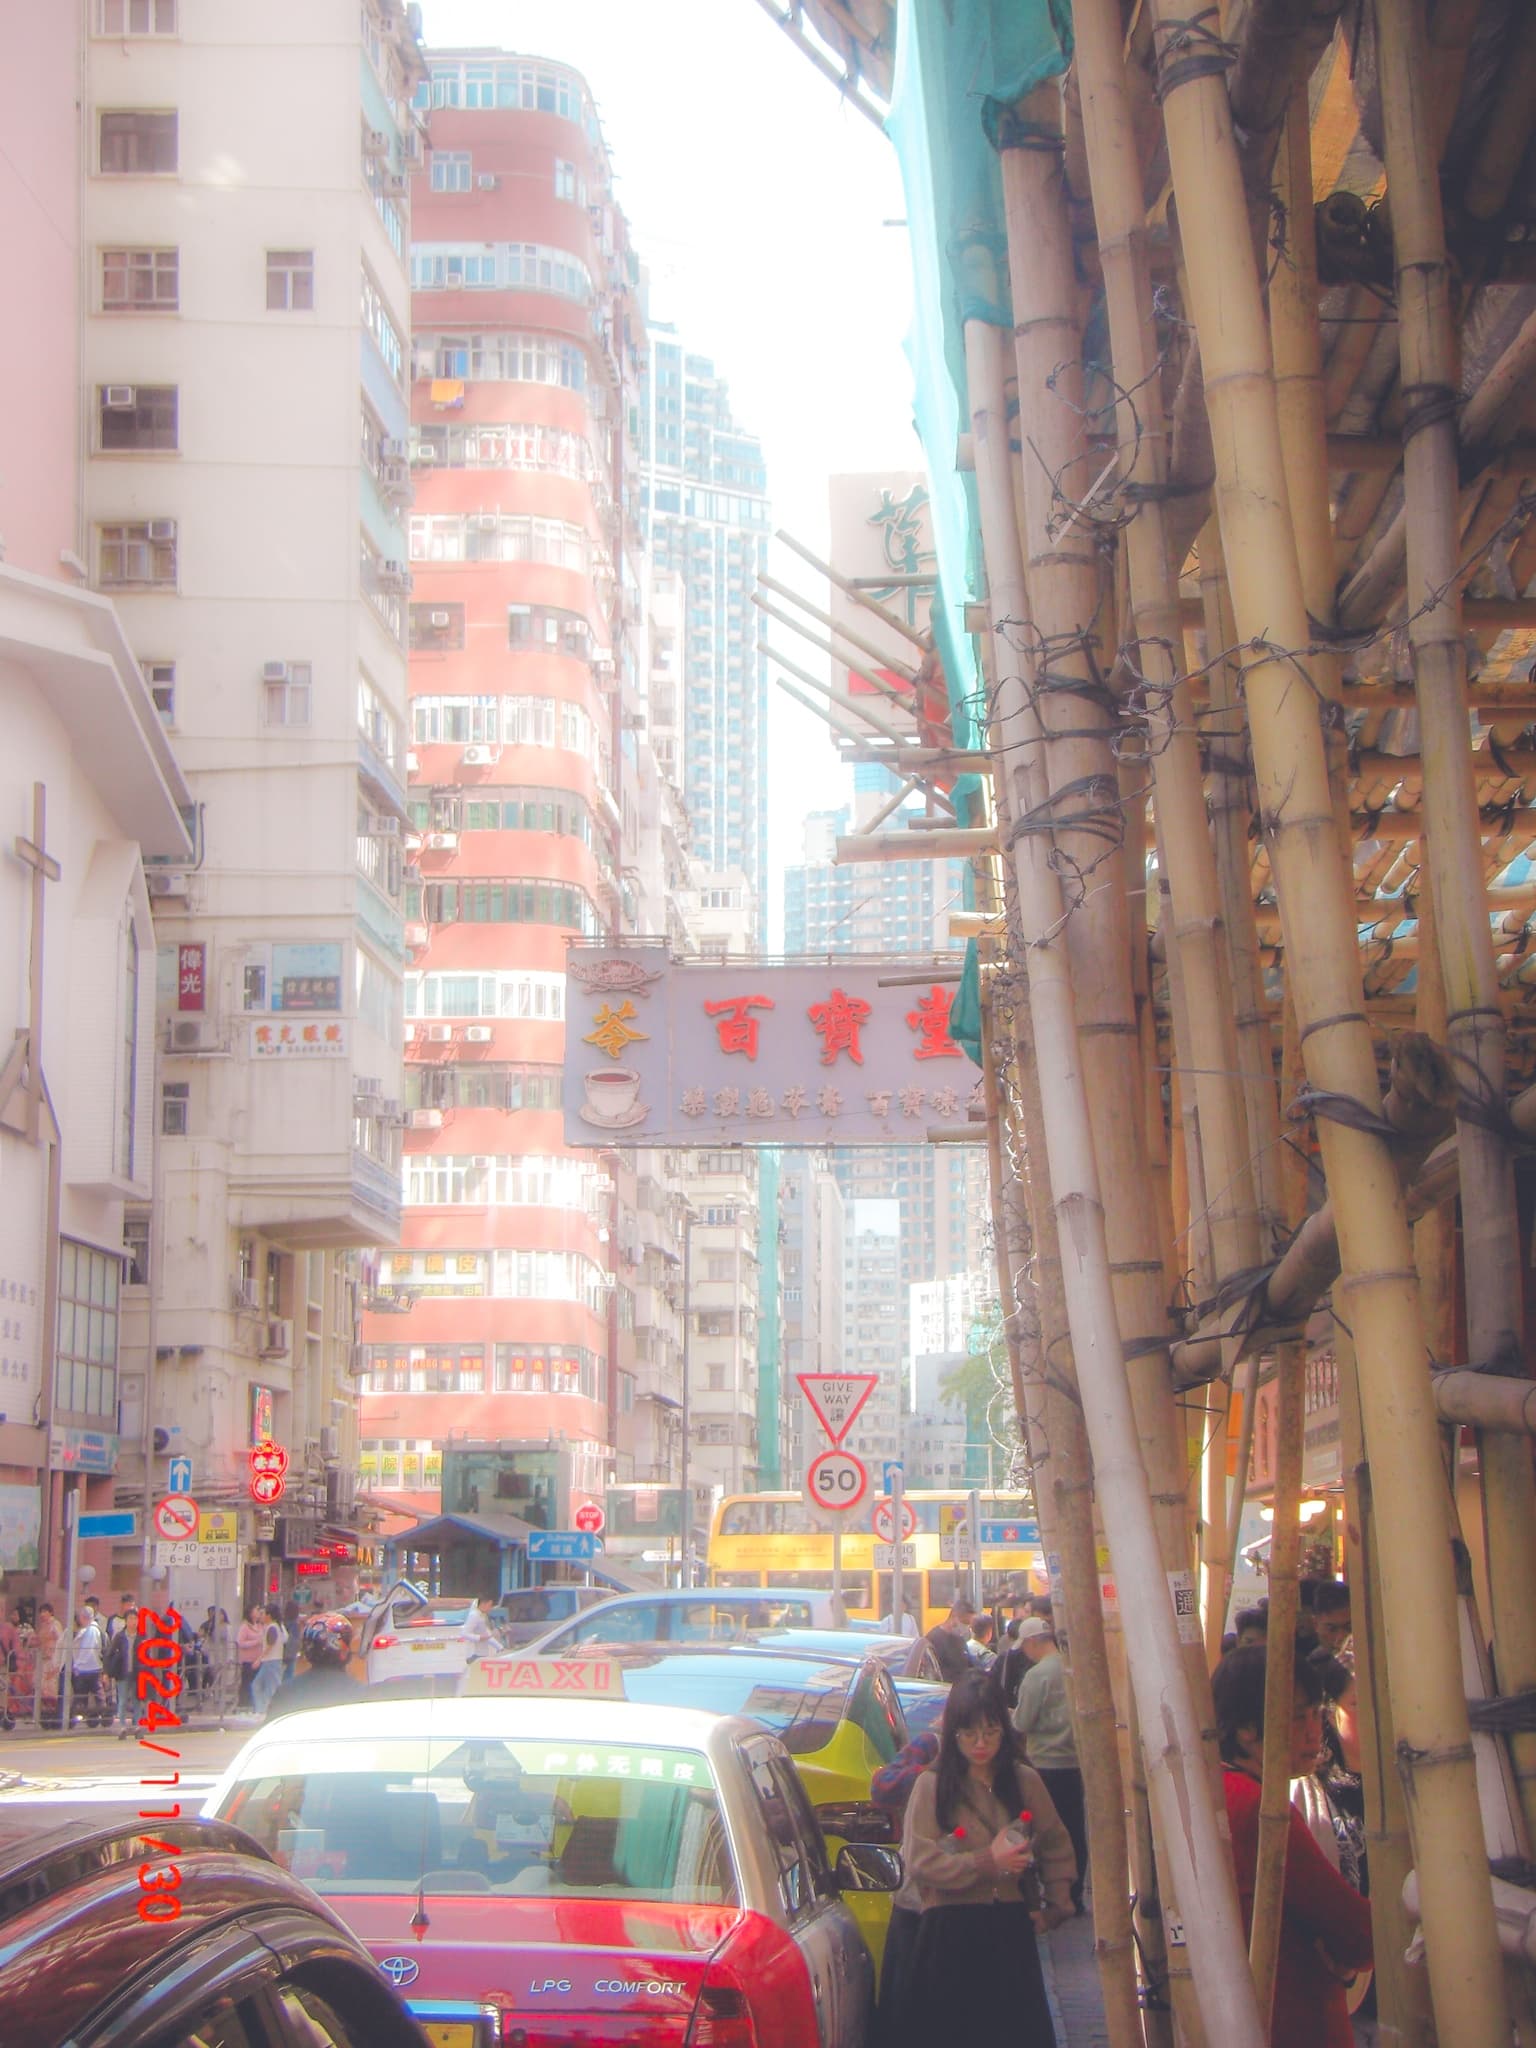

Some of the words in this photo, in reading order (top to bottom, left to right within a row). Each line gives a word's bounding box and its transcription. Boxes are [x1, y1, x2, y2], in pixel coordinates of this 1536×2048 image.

[180, 949, 202, 994] 偉光
[583, 998, 651, 1060] 苓
[704, 985, 964, 1066] 百寶堂
[822, 1381, 855, 1393] GIVE
[824, 1394, 852, 1405] WAY
[818, 1468, 857, 1492] 50
[201, 1545, 215, 1554] 24
[480, 1661, 610, 1690] TAXI
[530, 1979, 572, 1993] LPG
[594, 1979, 687, 1995] COMFORT
